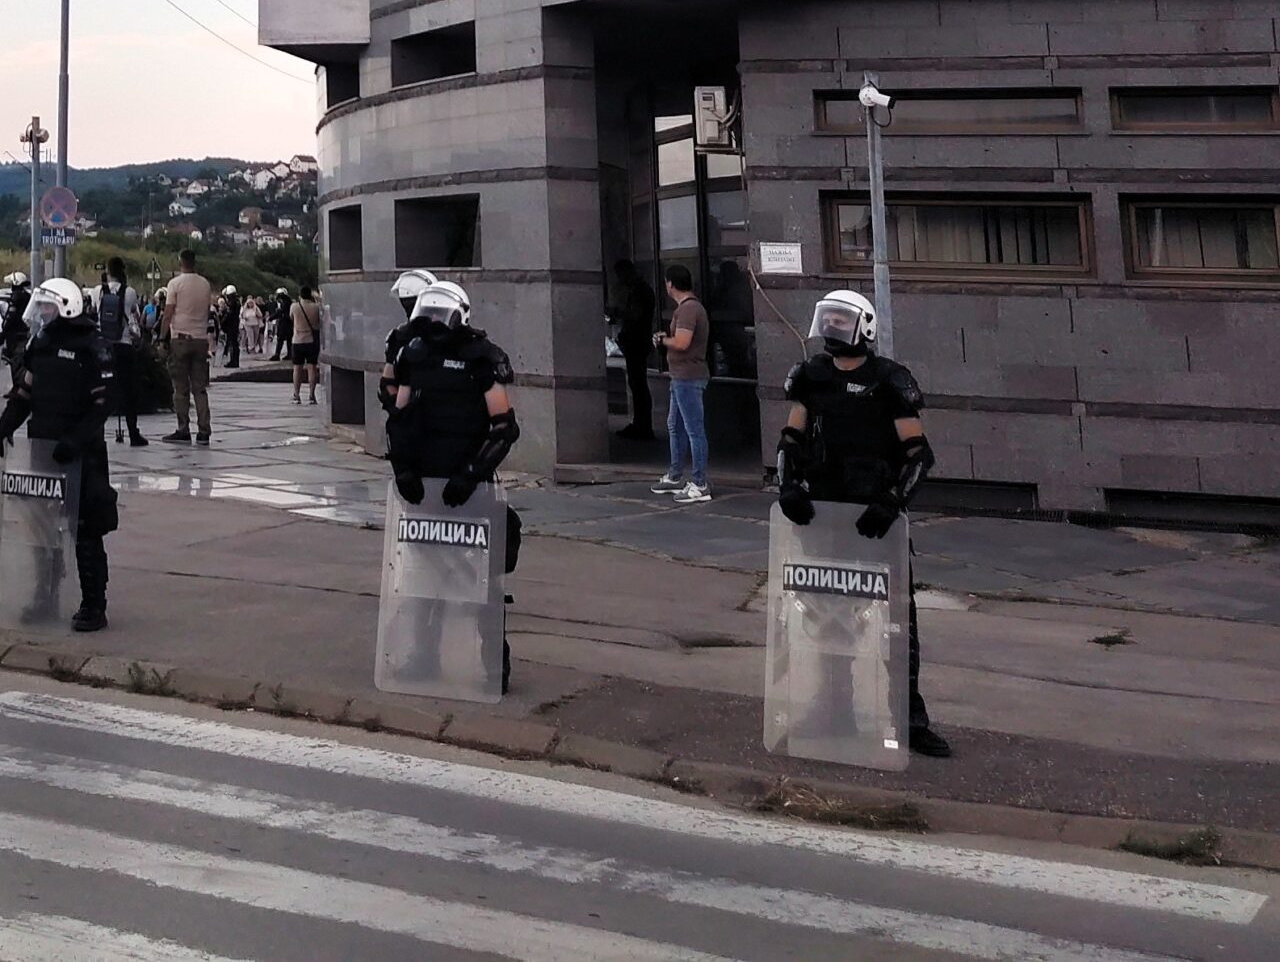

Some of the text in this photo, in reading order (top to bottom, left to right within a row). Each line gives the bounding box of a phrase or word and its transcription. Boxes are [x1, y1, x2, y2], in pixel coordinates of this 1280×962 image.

[2, 474, 63, 498] ПОЛИЦИЈА
[398, 520, 487, 546] ПОЛИЦИЈА
[784, 566, 887, 595] ПОЛИЦИЈА
